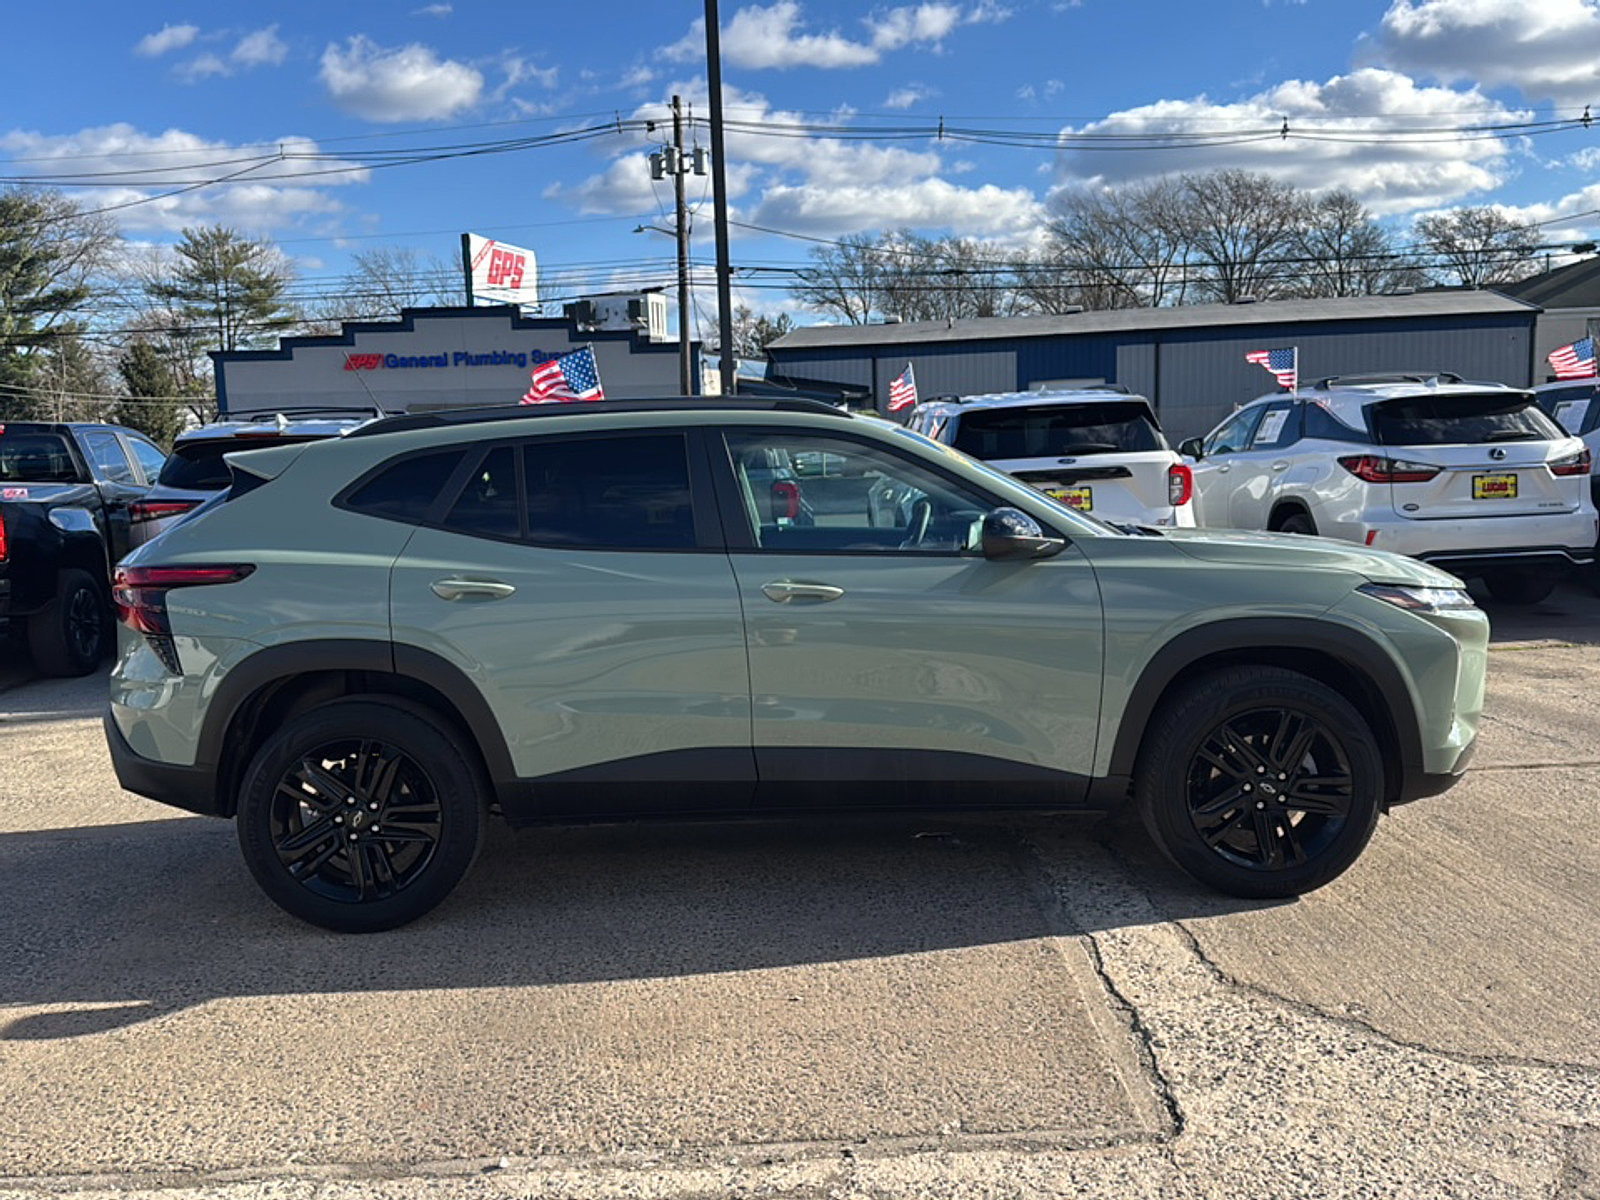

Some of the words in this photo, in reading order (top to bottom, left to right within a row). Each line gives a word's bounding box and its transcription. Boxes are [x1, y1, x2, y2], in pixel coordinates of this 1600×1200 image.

[487, 249, 526, 289] GPS
[385, 352, 448, 368] General
[453, 351, 527, 367] Plumbing
